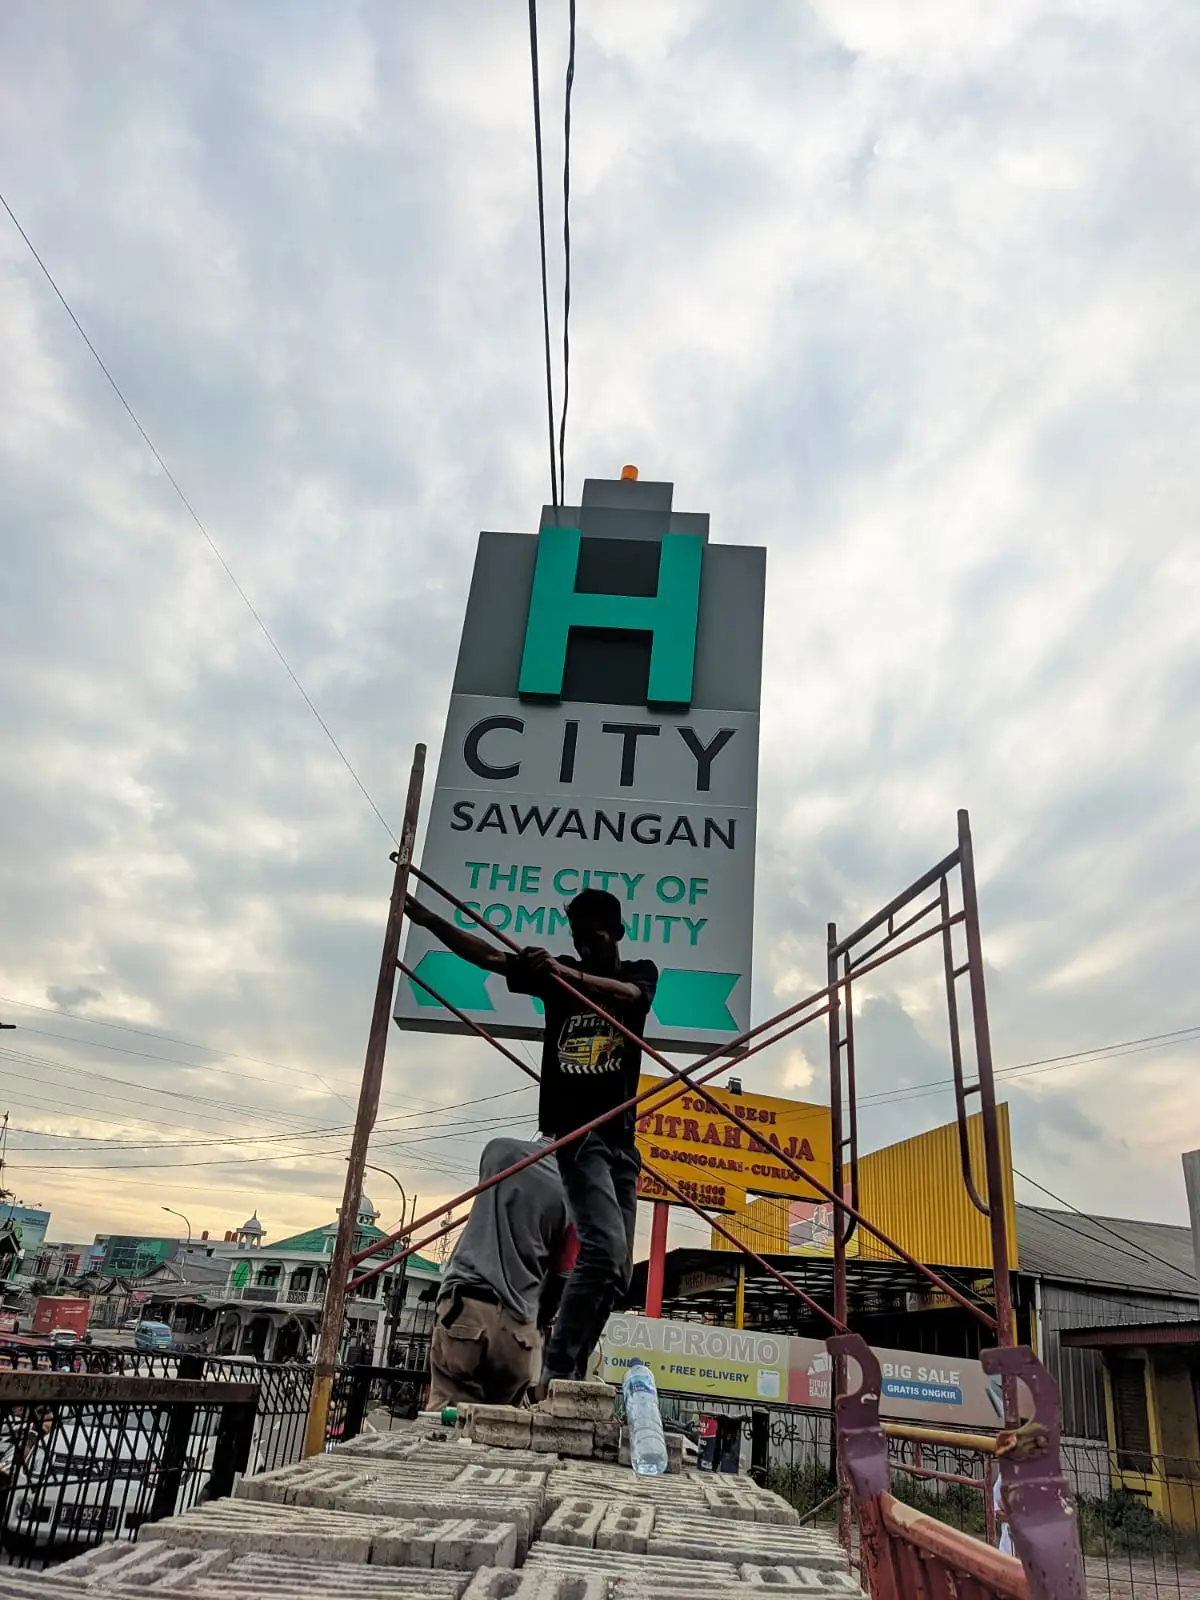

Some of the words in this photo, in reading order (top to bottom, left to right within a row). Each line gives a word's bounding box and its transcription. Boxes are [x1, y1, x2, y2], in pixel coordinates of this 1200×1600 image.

[518, 527, 702, 708] H
[463, 714, 738, 792] CITY
[450, 800, 736, 851] SAWANGAN
[464, 861, 542, 893] THE
[553, 868, 646, 901] CITY
[656, 875, 710, 905] OF
[454, 901, 708, 947] COMMNITY
[637, 1112, 742, 1150] FITRAH
[663, 1325, 779, 1365] PROMO
[670, 1365, 696, 1376] FREE
[699, 1368, 749, 1382] DELIVERY
[882, 1363, 912, 1379] BIG
[918, 1367, 960, 1385] SALE
[887, 1384, 919, 1395] GRATIS
[922, 1389, 956, 1399] ONGKIR
